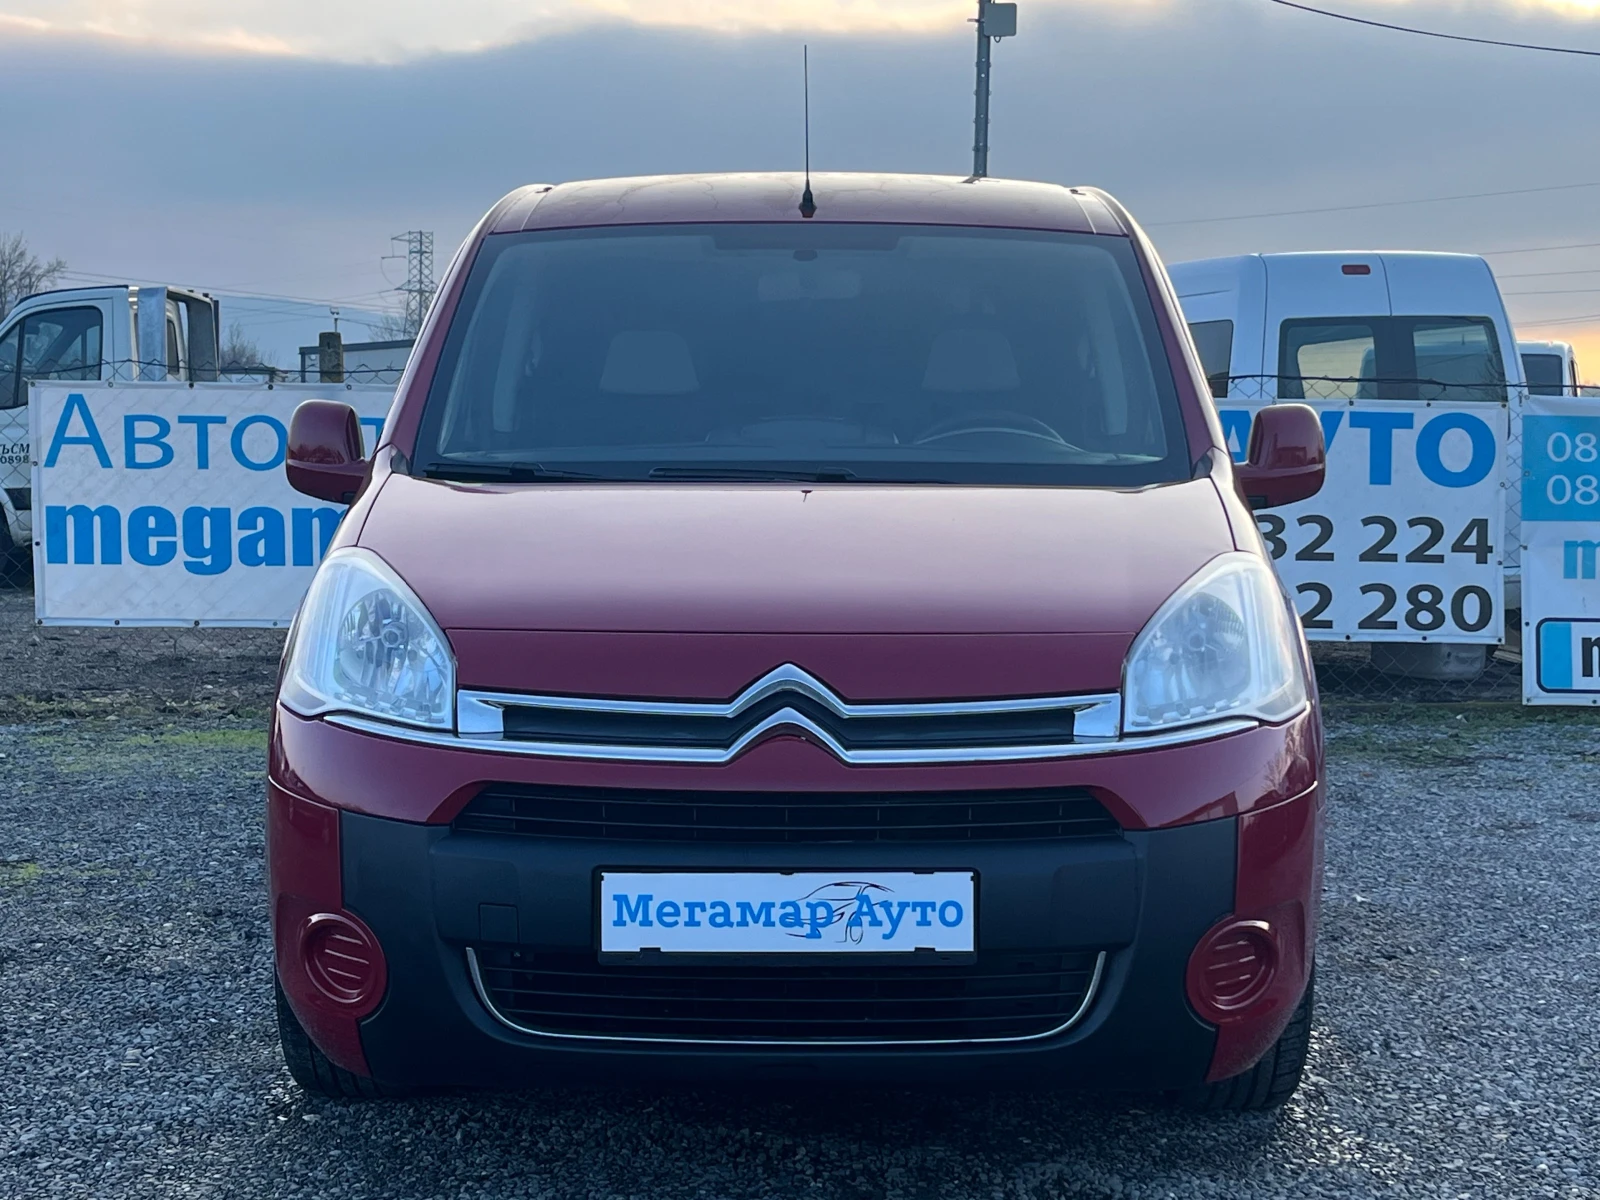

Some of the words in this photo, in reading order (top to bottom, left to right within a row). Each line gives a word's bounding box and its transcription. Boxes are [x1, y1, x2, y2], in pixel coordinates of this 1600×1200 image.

[1358, 515, 1493, 564] 224
[1357, 583, 1492, 632] 280
[612, 894, 834, 939] Мегамар
[848, 895, 964, 940] Ауто
